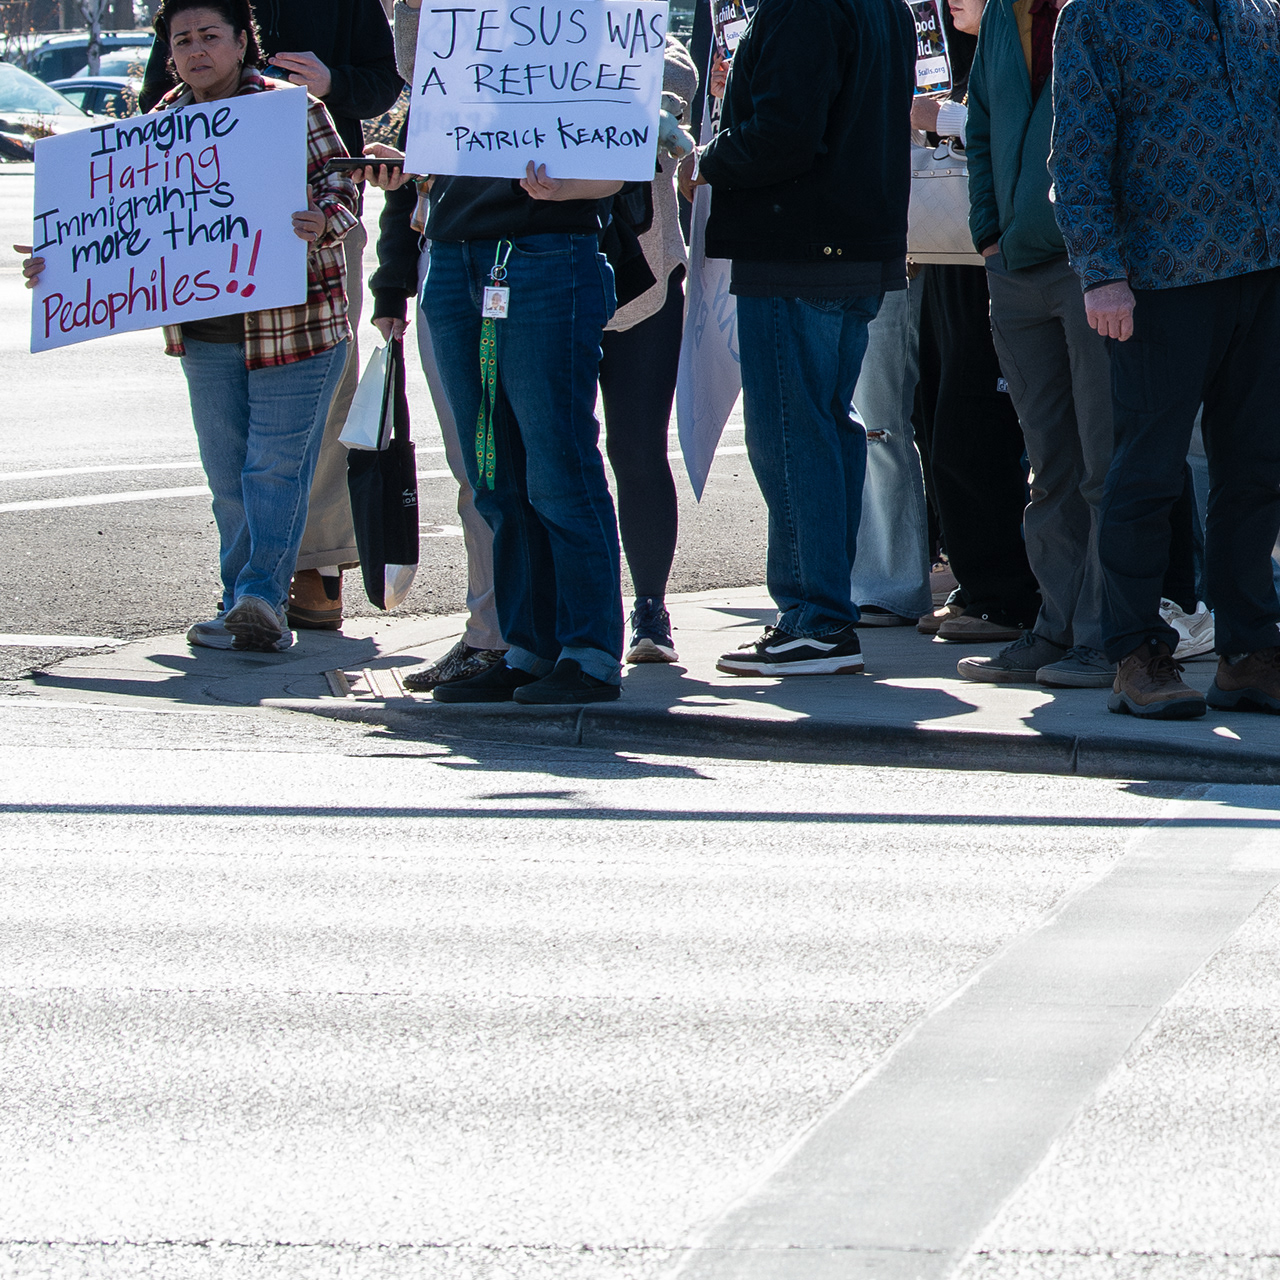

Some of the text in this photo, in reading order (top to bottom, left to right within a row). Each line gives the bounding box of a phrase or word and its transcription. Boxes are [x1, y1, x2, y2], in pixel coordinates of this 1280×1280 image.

[431, 6, 664, 59] JESUS WAS
[719, 3, 737, 23] child
[915, 15, 936, 33] ood
[917, 39, 933, 57] ild
[421, 61, 642, 96] A REFUGEE
[918, 66, 945, 77] 5calls.org
[90, 106, 239, 157] Imagine
[557, 117, 649, 150] KEARON
[89, 144, 222, 199] Hating
[33, 178, 235, 253] Immigrants
[72, 209, 250, 272] more than
[42, 229, 263, 339] Pedophiles!!
